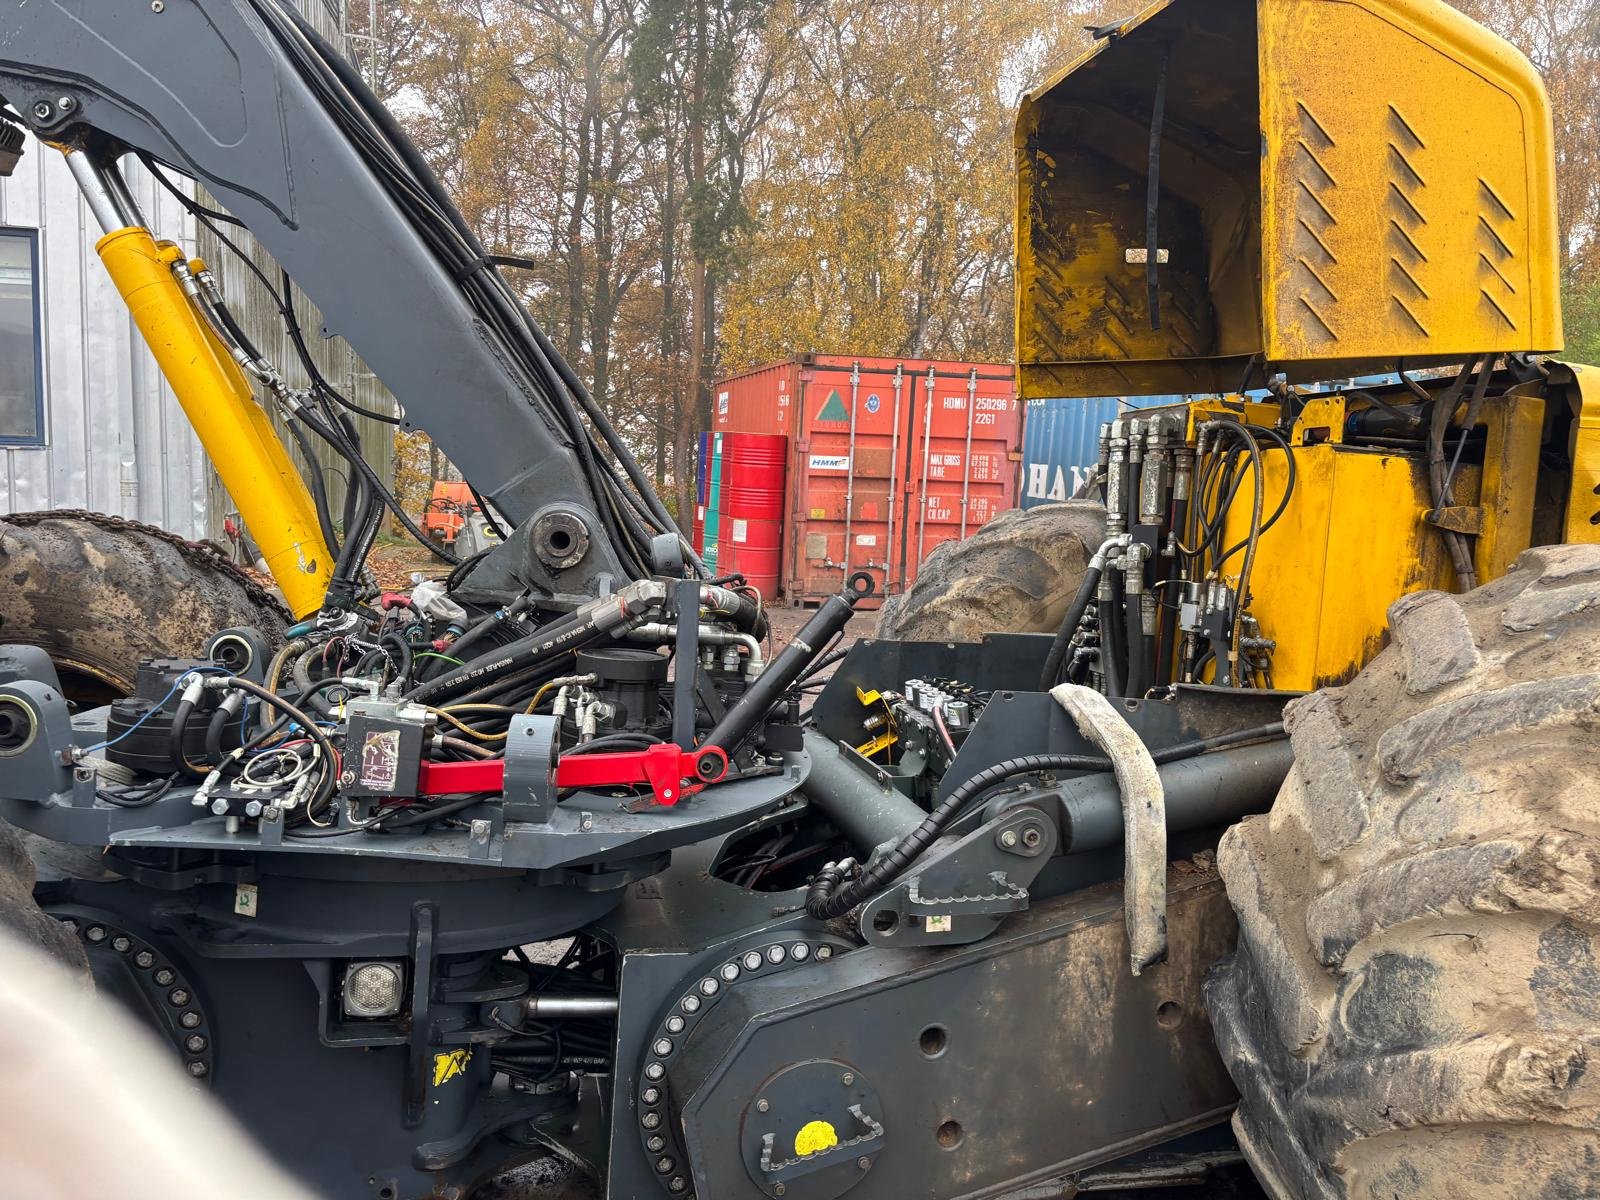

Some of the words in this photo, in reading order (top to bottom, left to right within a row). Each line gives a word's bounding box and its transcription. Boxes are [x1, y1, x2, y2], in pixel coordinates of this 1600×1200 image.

[943, 397, 967, 409] HDMU
[976, 398, 1007, 411] 250296
[975, 413, 995, 424] 2261
[811, 459, 839, 467] HMM
[930, 454, 943, 465] MAX
[944, 455, 960, 466] GROSS
[930, 466, 945, 478] TARE
[928, 497, 941, 508] NET
